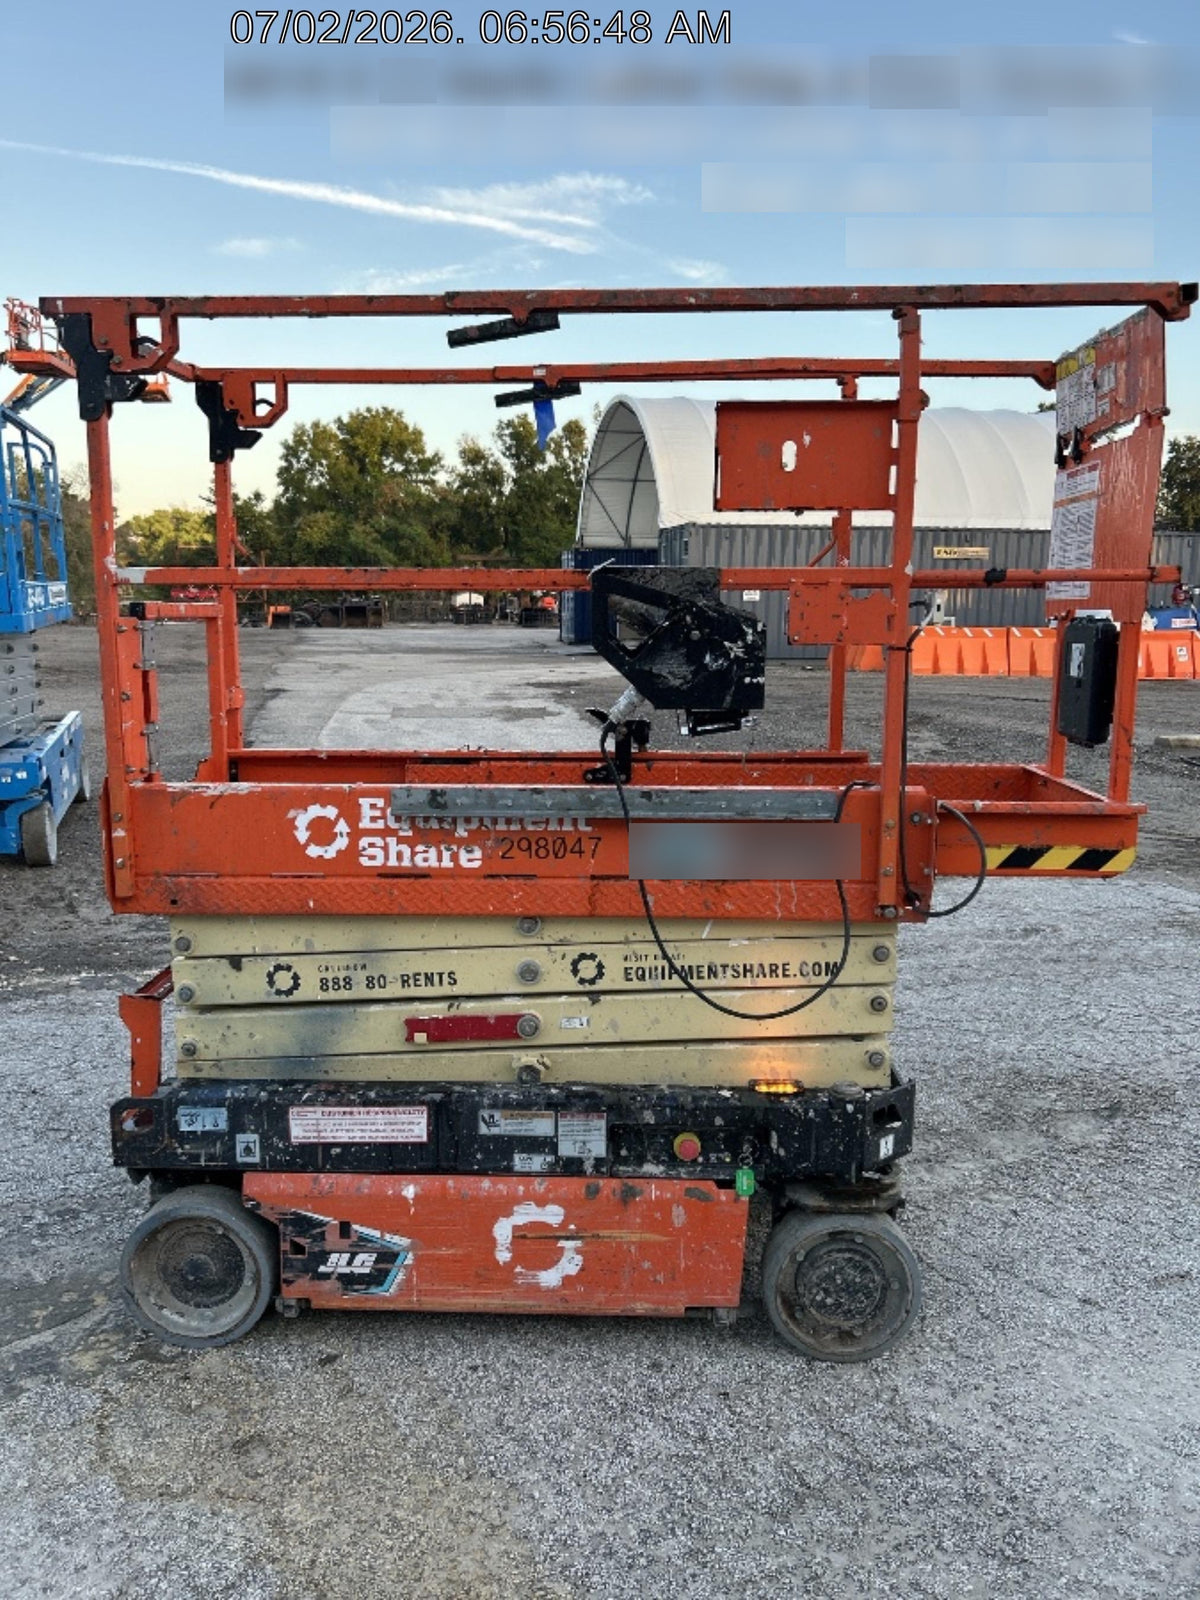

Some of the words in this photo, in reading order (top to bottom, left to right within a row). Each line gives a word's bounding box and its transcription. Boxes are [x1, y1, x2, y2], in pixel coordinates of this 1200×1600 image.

[358, 836, 483, 868] Share
[500, 837, 602, 860] 298047
[318, 1253, 377, 1273] JLG
